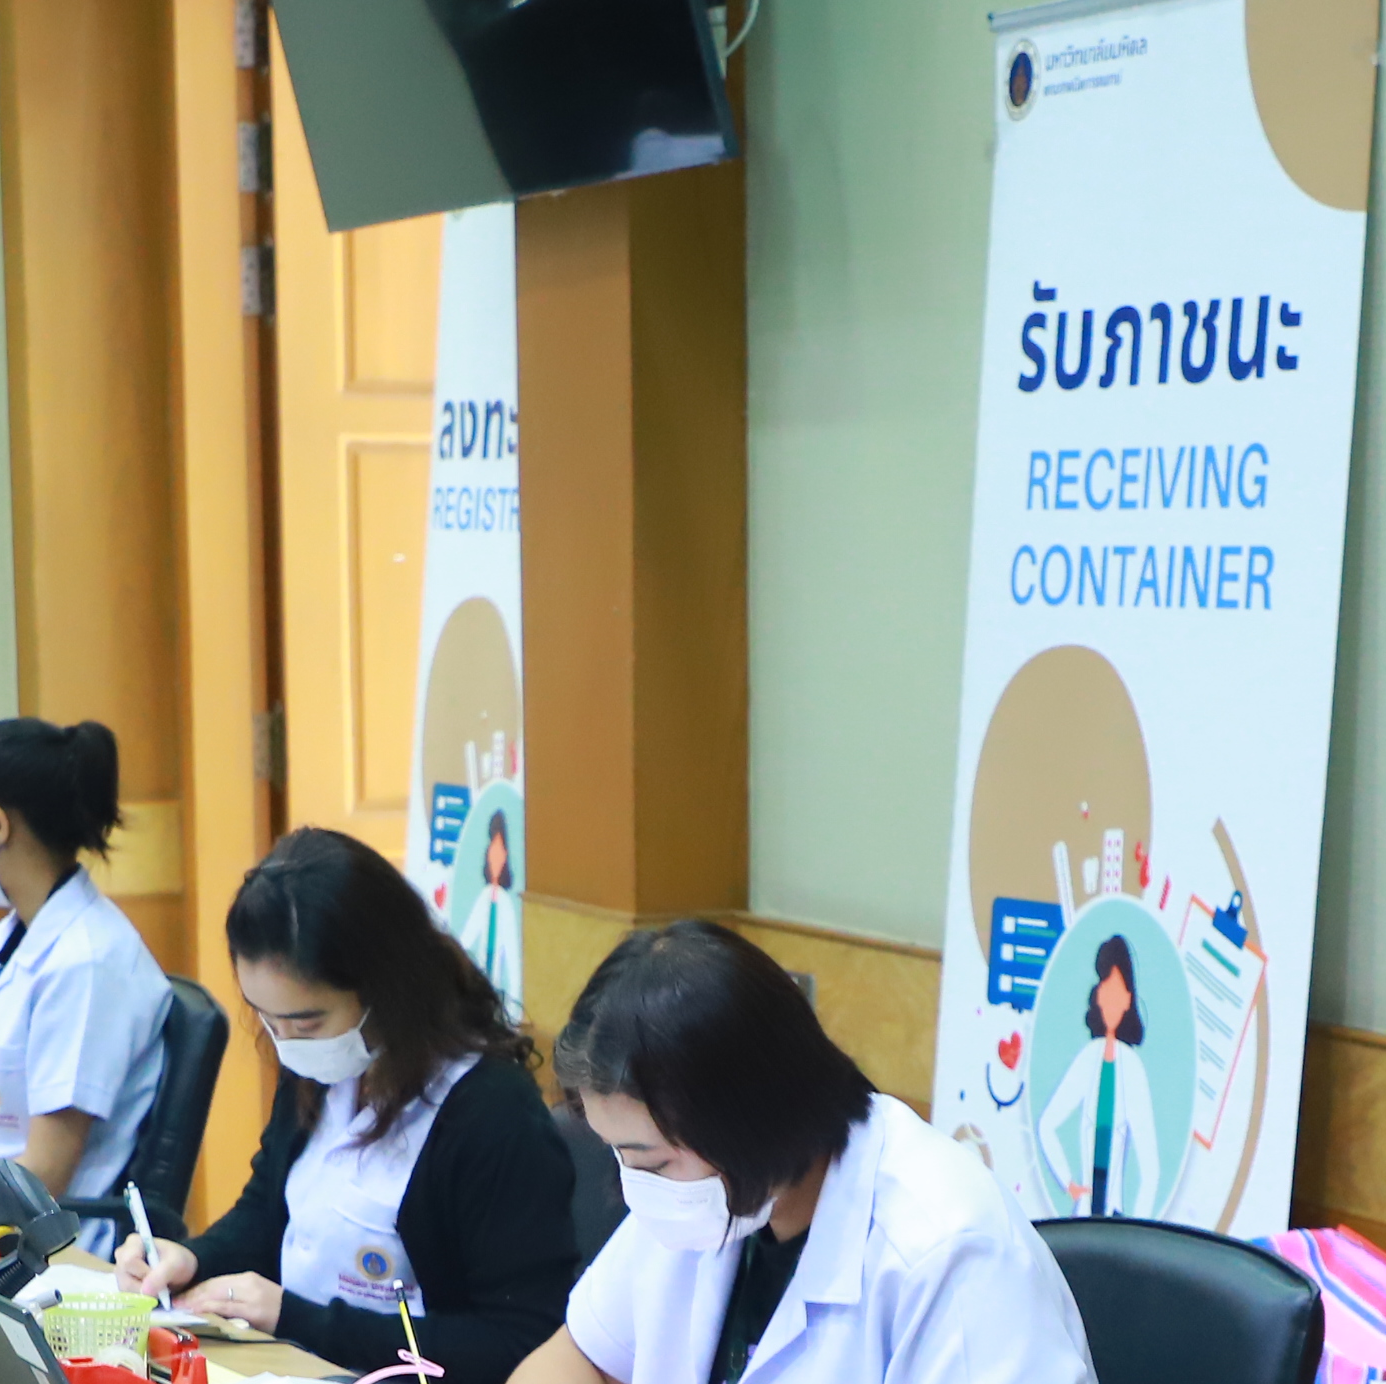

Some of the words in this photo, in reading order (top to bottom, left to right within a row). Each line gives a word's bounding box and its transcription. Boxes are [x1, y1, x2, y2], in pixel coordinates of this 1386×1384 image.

[1017, 279, 1303, 393] รับภาชนะ
[1026, 442, 1270, 511] RECEIVING
[1010, 544, 1275, 611] CONTAINER
